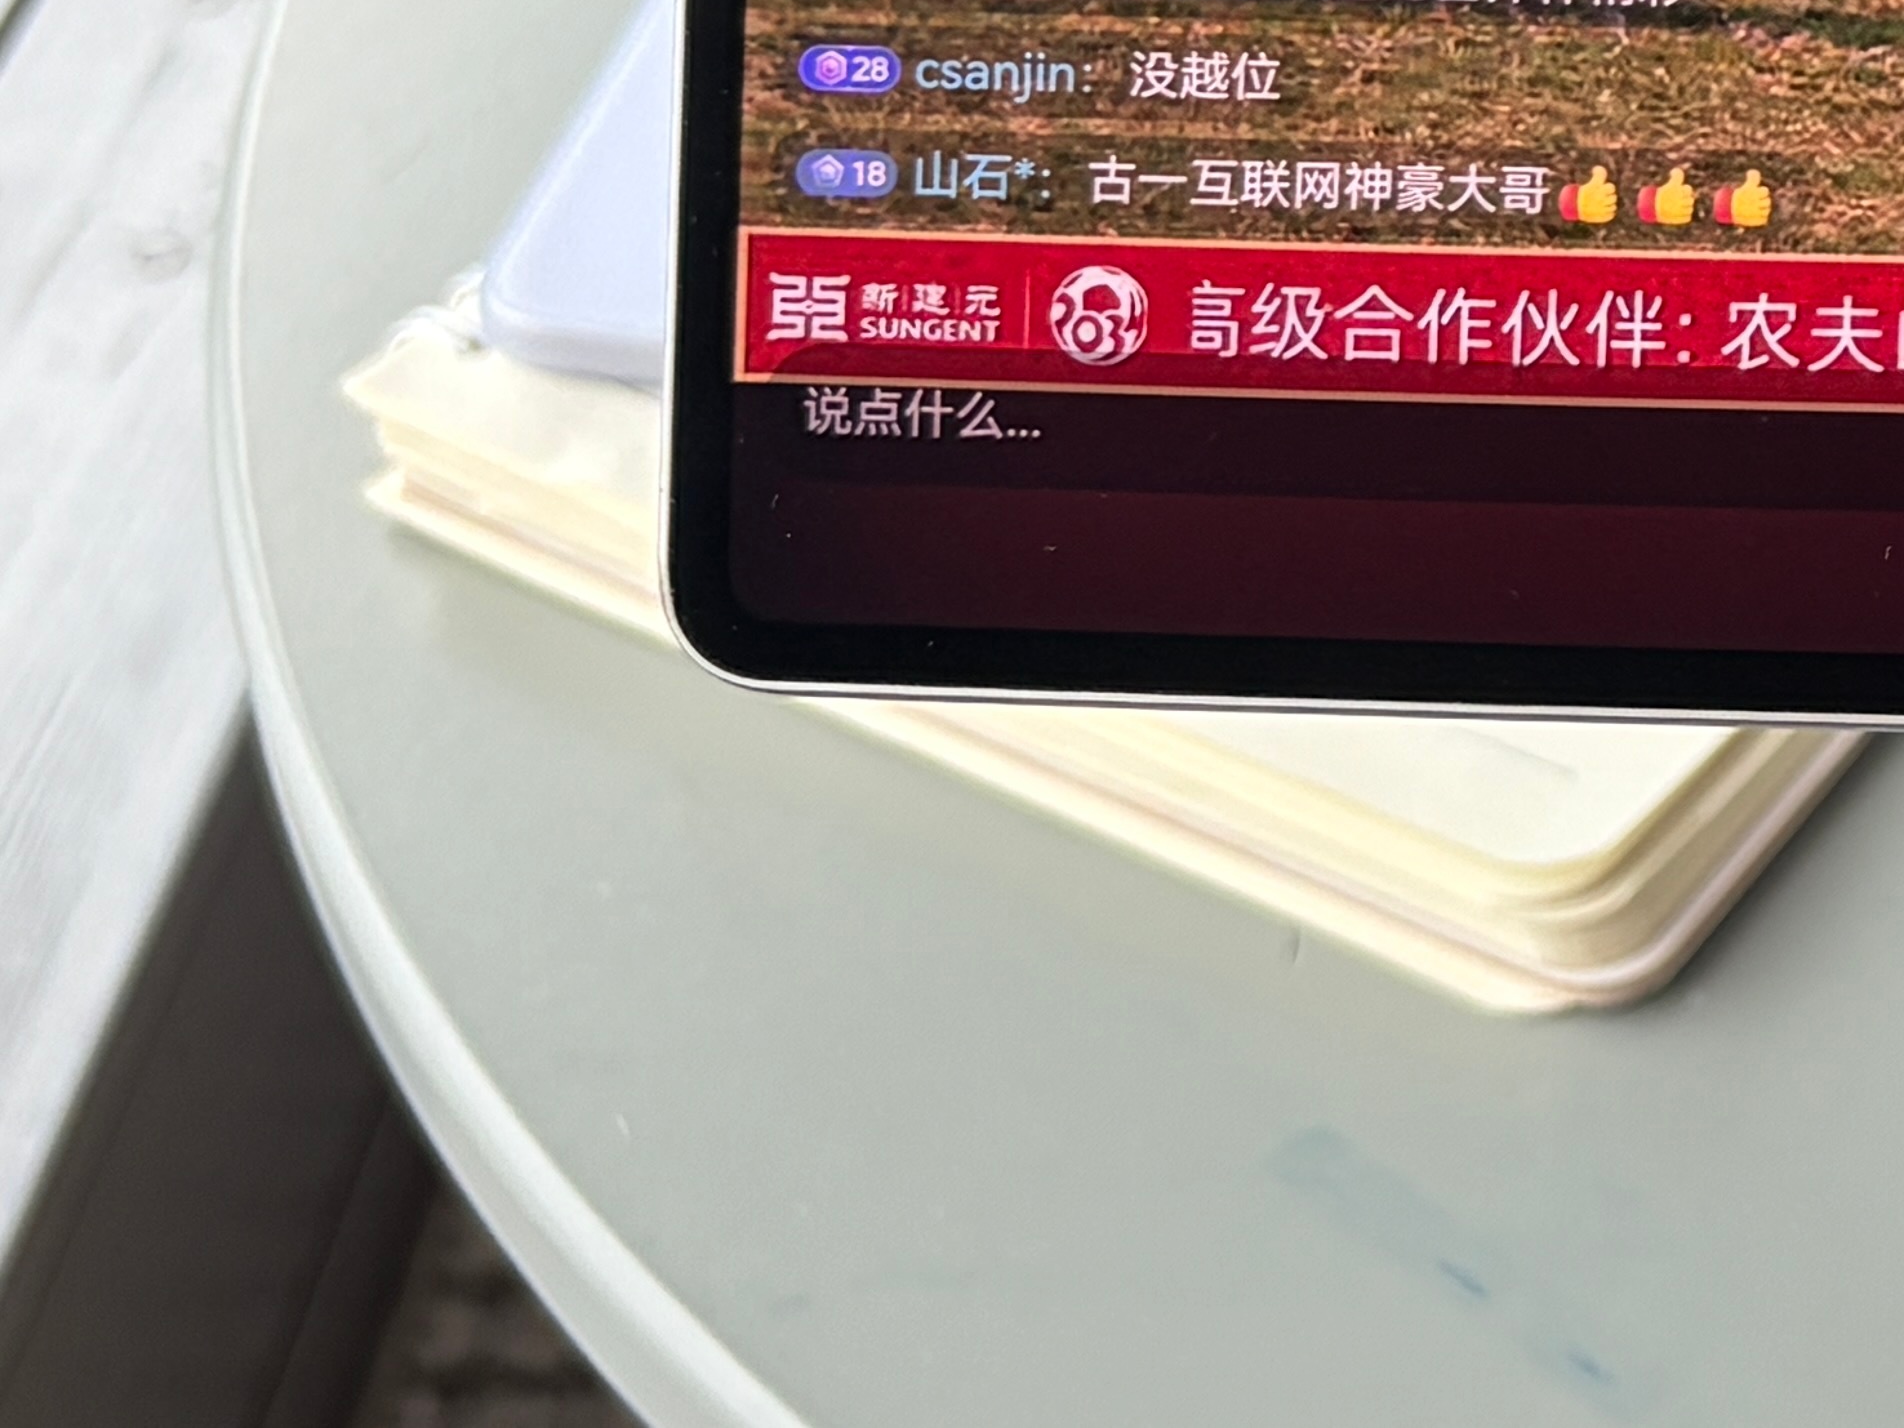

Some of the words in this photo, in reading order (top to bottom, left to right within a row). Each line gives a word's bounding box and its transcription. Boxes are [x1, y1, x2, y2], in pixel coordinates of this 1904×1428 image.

[851, 55, 889, 84] 28
[1128, 50, 1281, 103] 没越位
[852, 158, 887, 188] 18
[1087, 155, 1552, 219] 古一互联网神豪大哥
[859, 316, 1001, 343] SUNGENT
[802, 386, 1042, 442] 说点什么...
